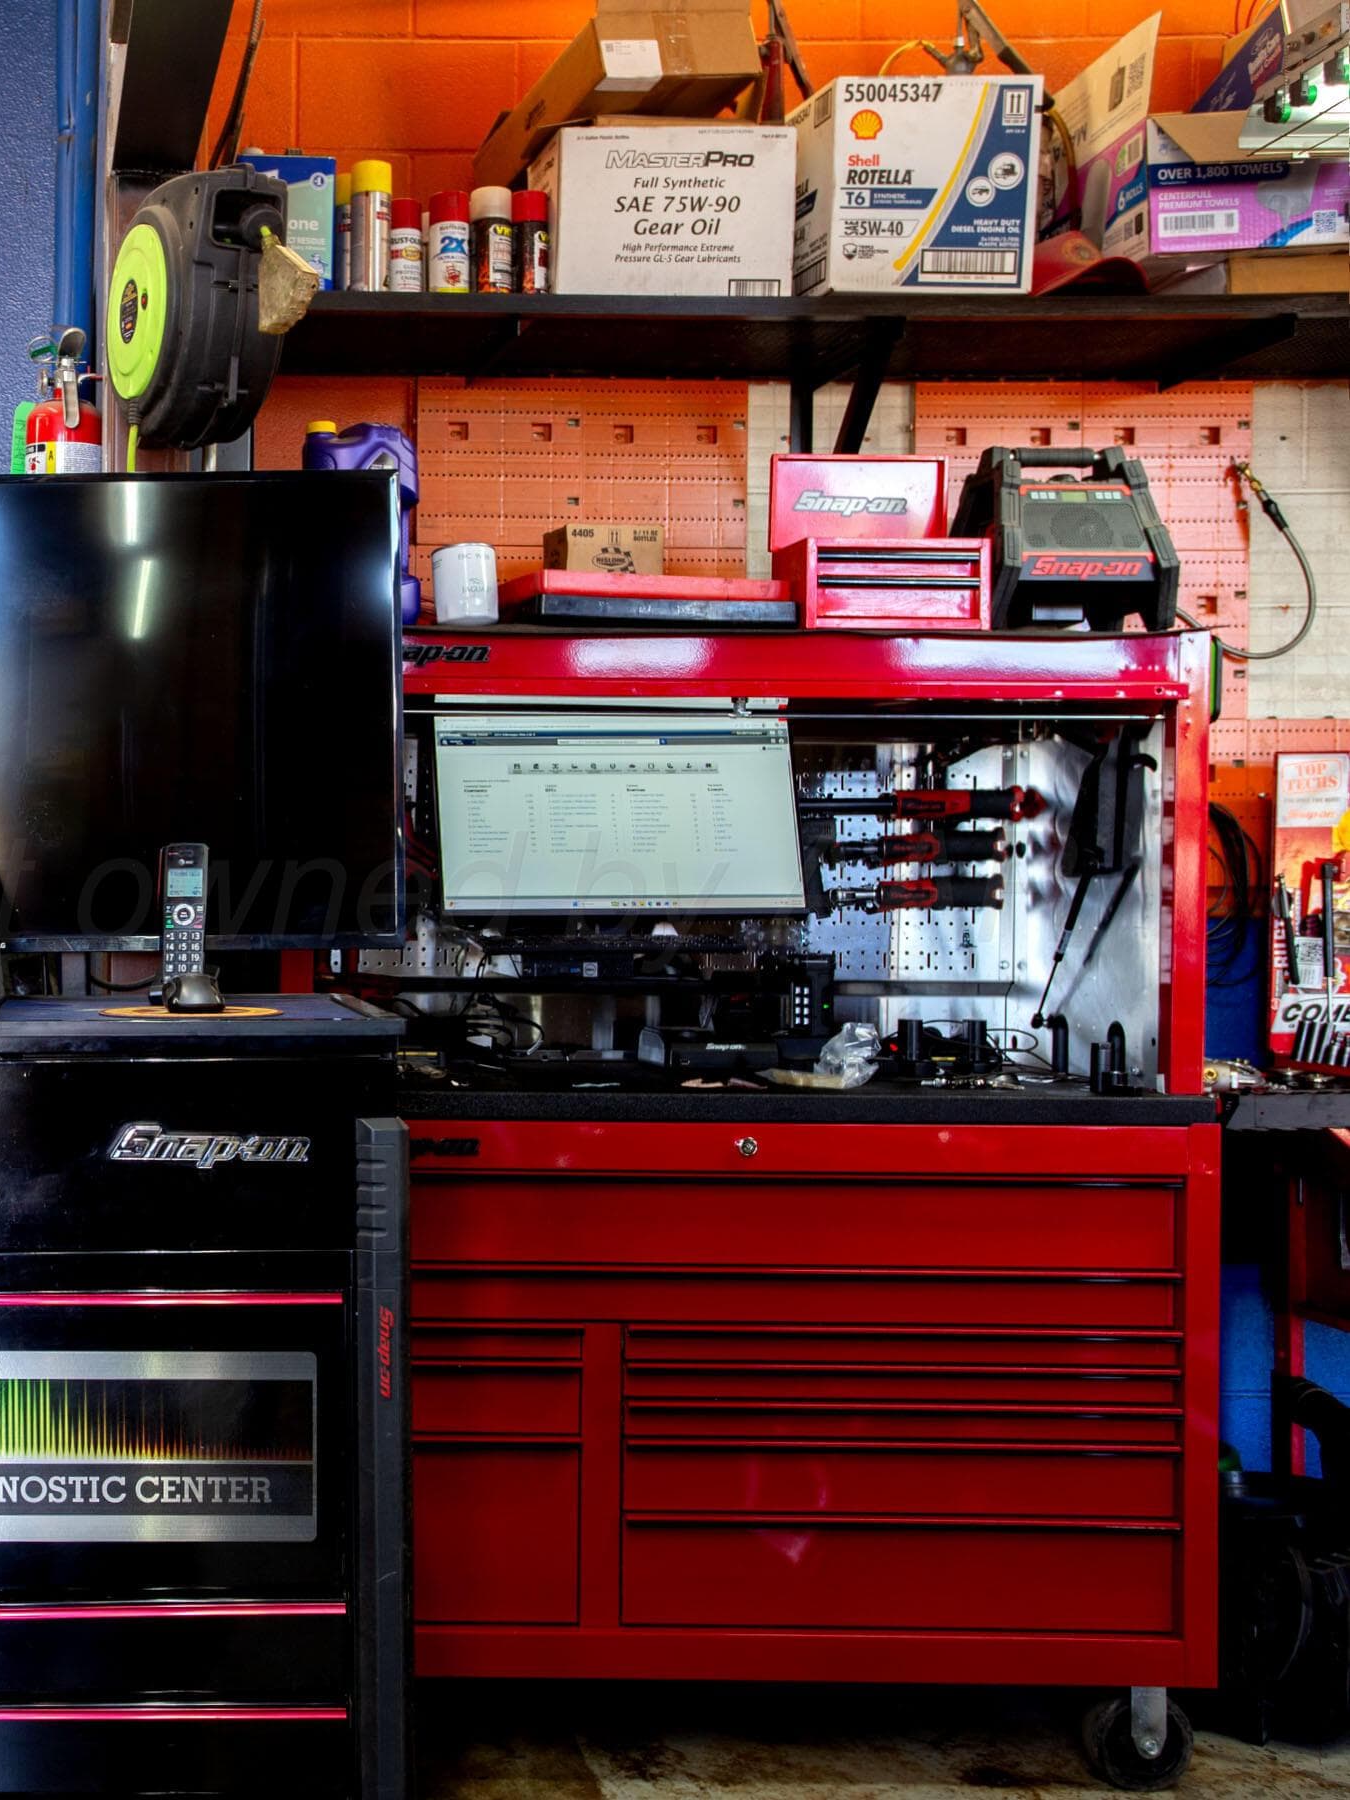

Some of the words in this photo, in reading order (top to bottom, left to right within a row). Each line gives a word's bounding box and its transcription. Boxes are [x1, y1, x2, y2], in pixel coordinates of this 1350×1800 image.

[844, 83, 943, 103] 550045347
[848, 154, 880, 167] Shell
[846, 169, 913, 185] ROTELLA
[1158, 169, 1192, 180] OVER
[1196, 167, 1229, 180] 1,800
[633, 177, 658, 189] Full
[663, 177, 726, 190] Synthetic
[845, 191, 866, 206] T6
[1118, 191, 1126, 210] 6
[1158, 191, 1212, 201] CENTERPULL
[614, 196, 655, 213] SAE
[663, 196, 741, 213] 75W-90
[1158, 200, 1202, 210] PREMIUM
[1205, 198, 1239, 208] TOWELS
[633, 219, 684, 235] Gear
[691, 218, 721, 235] Oil
[859, 221, 904, 236] 5W-40
[440, 236, 467, 254] 2X
[622, 243, 642, 253] High
[644, 243, 698, 253] Performance
[700, 243, 734, 252] Extreme
[615, 254, 650, 263] Pressure
[653, 254, 672, 263] GL-5
[675, 254, 695, 263] Gear
[697, 254, 741, 264] Lubricants
[793, 490, 908, 517] Snap-on
[571, 529, 594, 538] 4405
[1030, 555, 1143, 581] Snap-on
[403, 643, 490, 667] ap-on
[1294, 763, 1326, 777] TOP
[1287, 776, 1338, 791] TECHS
[110, 1121, 312, 1169] Snap-on
[378, 1306, 395, 1399] Snap-on
[135, 1475, 272, 1504] CENTER
